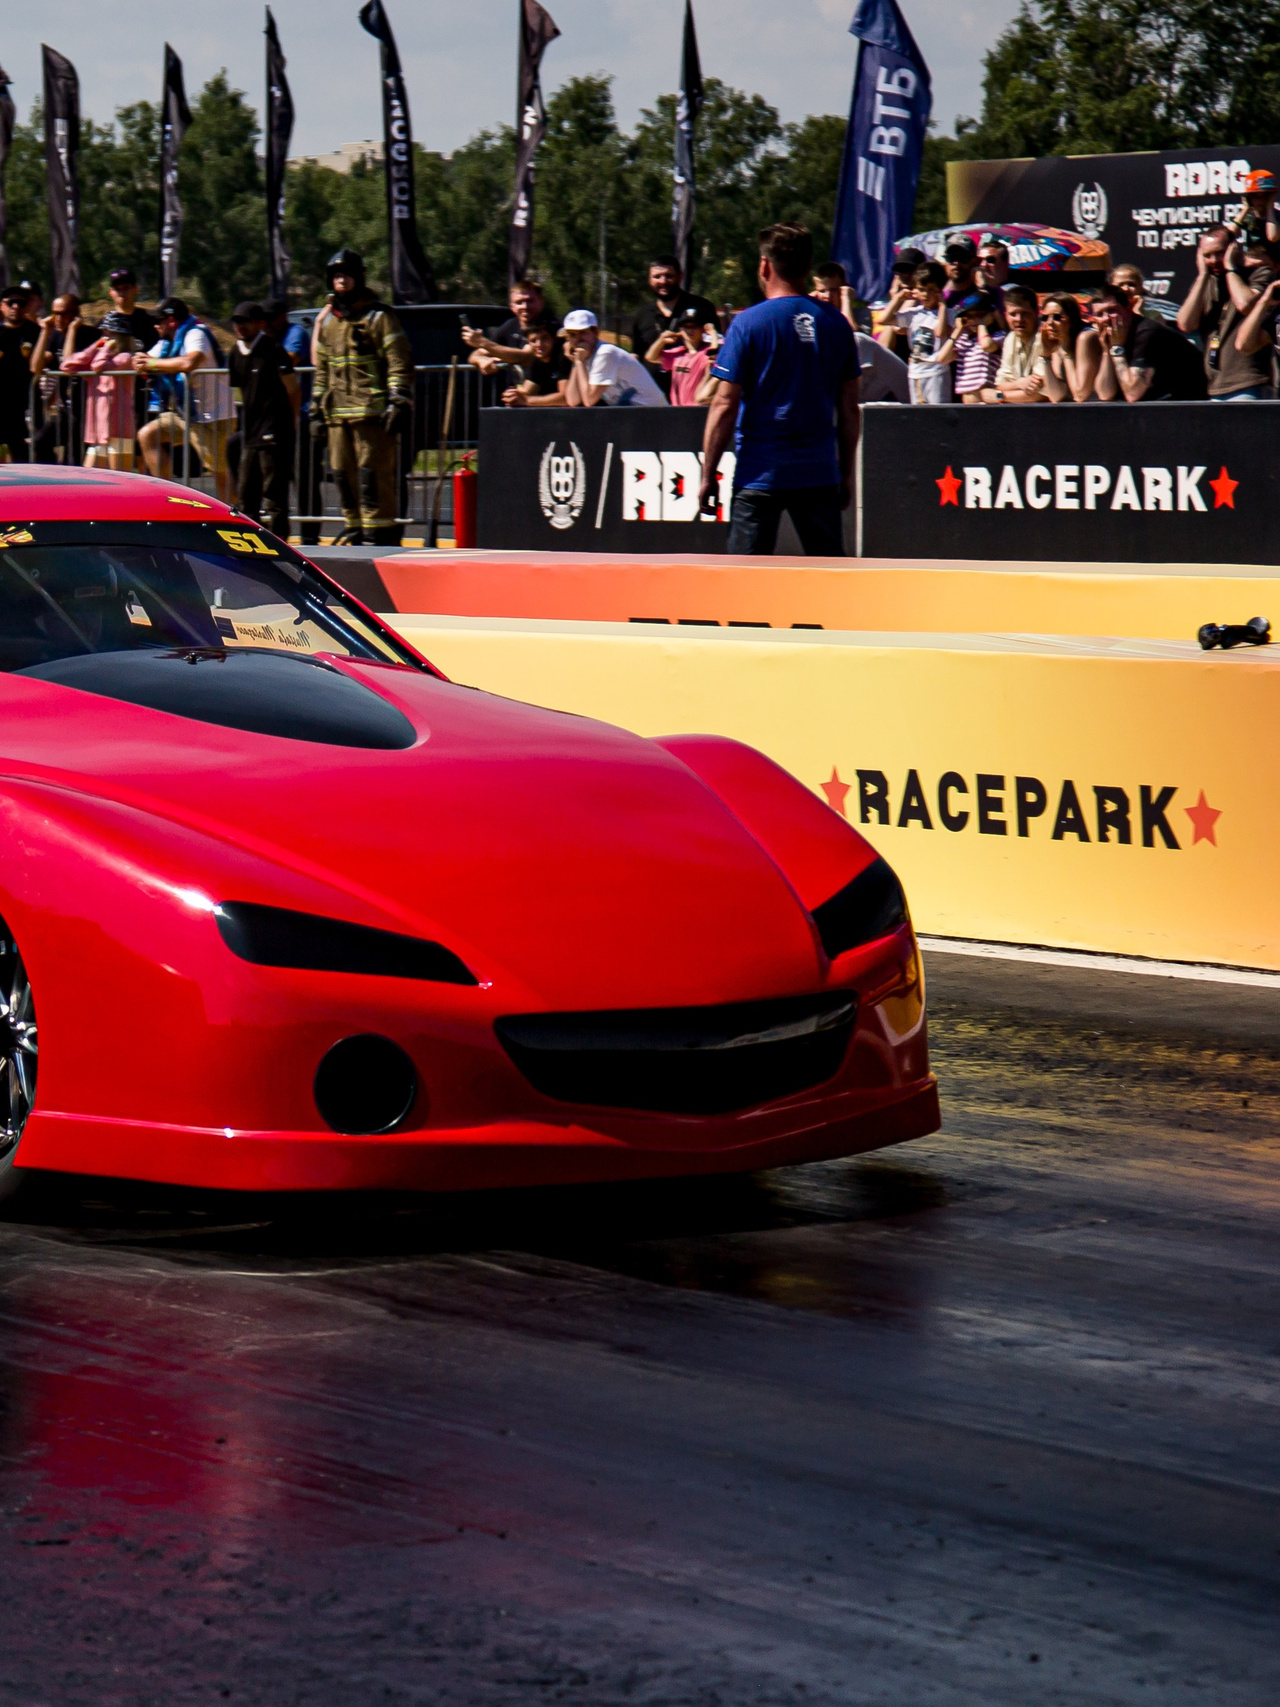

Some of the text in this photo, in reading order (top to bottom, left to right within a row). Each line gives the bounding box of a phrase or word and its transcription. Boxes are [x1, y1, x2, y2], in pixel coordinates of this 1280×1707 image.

[869, 66, 917, 156] ВТБ
[963, 464, 1208, 512] RACEPARK
[216, 529, 279, 556] 51
[855, 769, 1182, 850] RACEPARK
